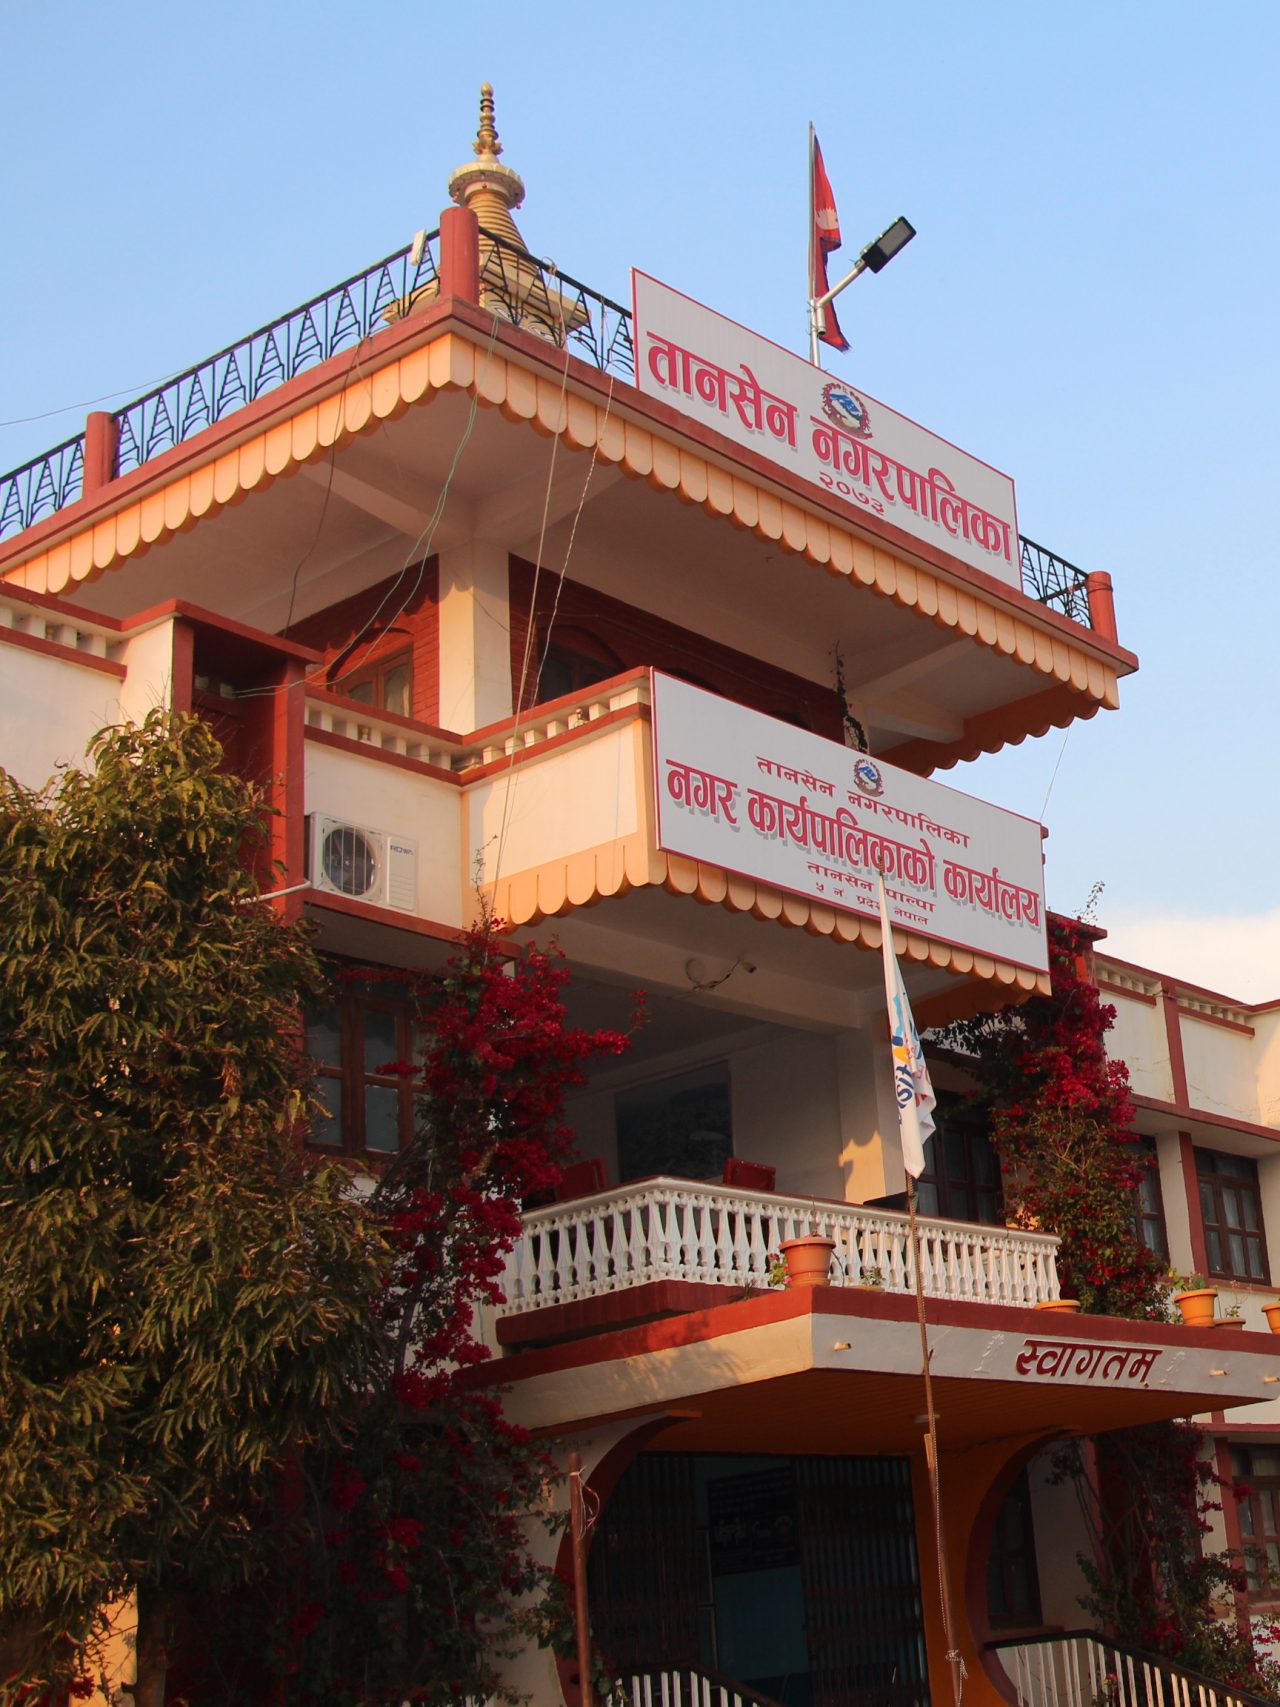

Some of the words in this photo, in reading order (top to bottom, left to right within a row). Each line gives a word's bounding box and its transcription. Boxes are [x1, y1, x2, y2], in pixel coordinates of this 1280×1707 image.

[646, 331, 798, 448] तानसेन
[810, 416, 1011, 560] नगरपालिका
[819, 471, 885, 515] २०७३
[756, 756, 835, 797] तानसेन
[847, 790, 970, 848] नगरपालिका
[666, 759, 738, 824] नगर
[747, 788, 935, 890] कार्यपालिकाको
[943, 859, 1039, 926] कार्यालय
[806, 860, 873, 892] तानसेन
[884, 888, 936, 912] पाल्पा
[894, 906, 928, 925] नेपाल
[1016, 1339, 1163, 1389] स्वागतम्
